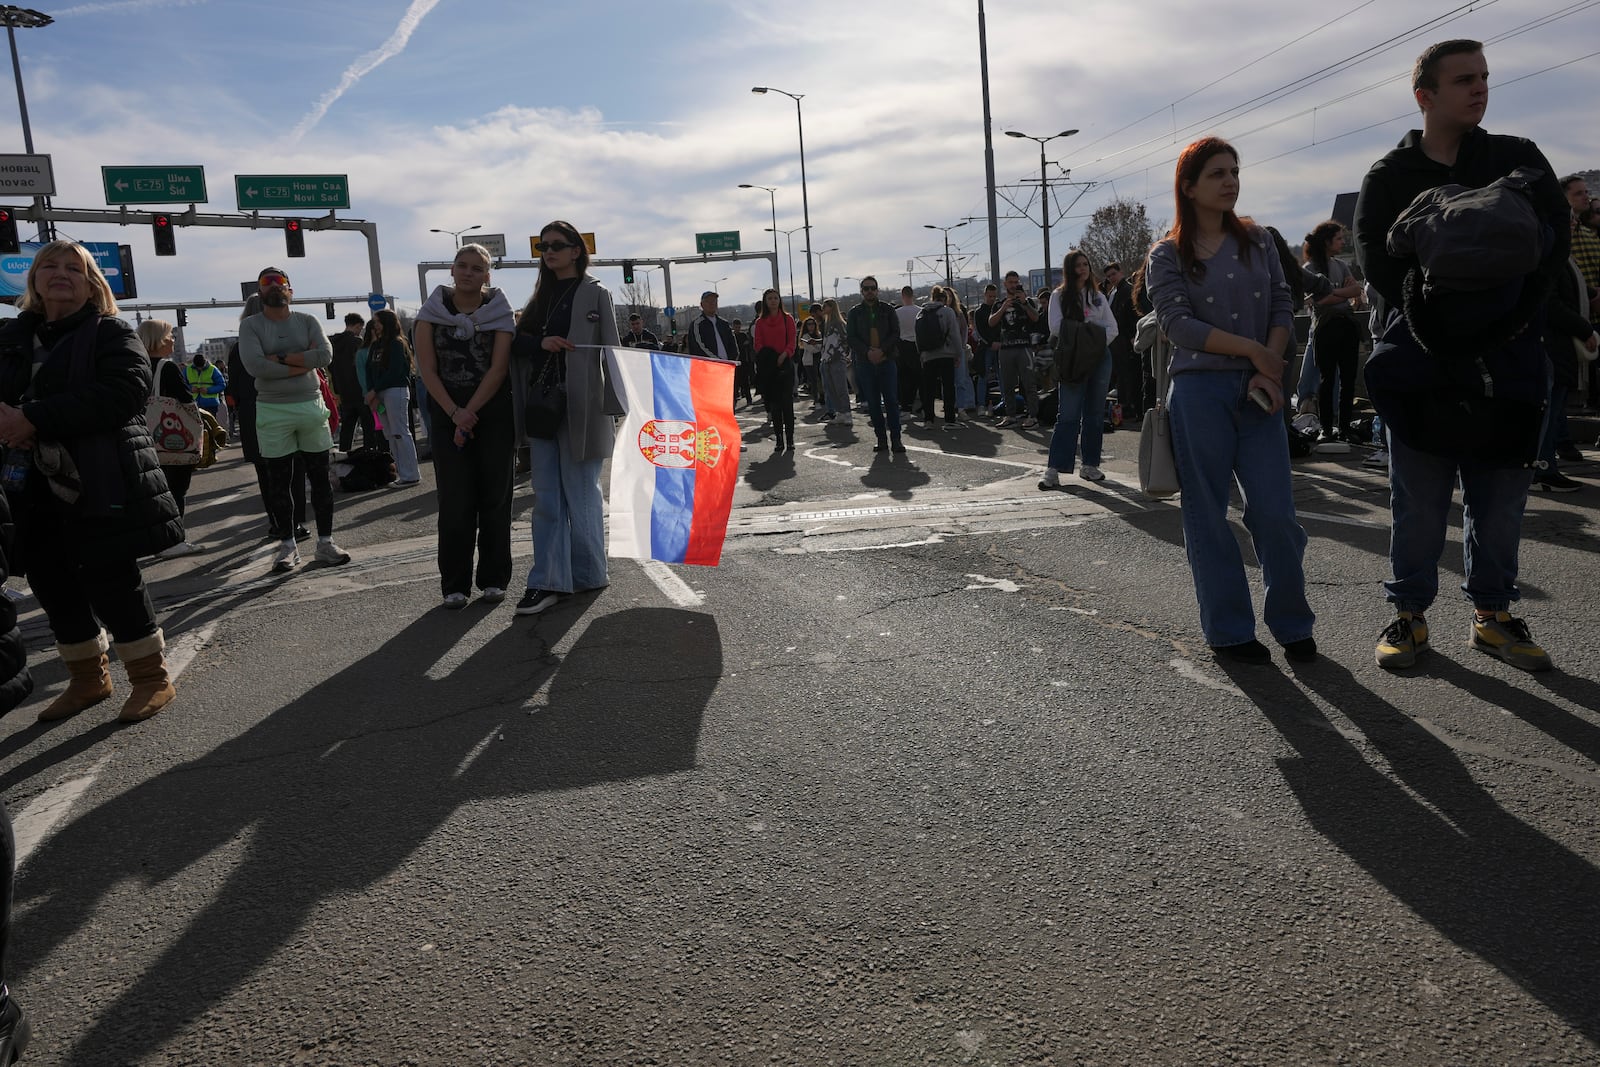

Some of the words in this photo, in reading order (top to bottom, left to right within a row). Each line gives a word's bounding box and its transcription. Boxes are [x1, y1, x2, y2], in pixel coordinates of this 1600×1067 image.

[168, 173, 191, 183] Шид
[136, 181, 162, 190] E-75
[169, 184, 186, 196] Šid
[293, 182, 317, 190] Нови
[323, 182, 341, 190] Сад
[266, 188, 288, 196] E-75
[294, 193, 315, 202] Novi
[321, 193, 339, 202] Sad
